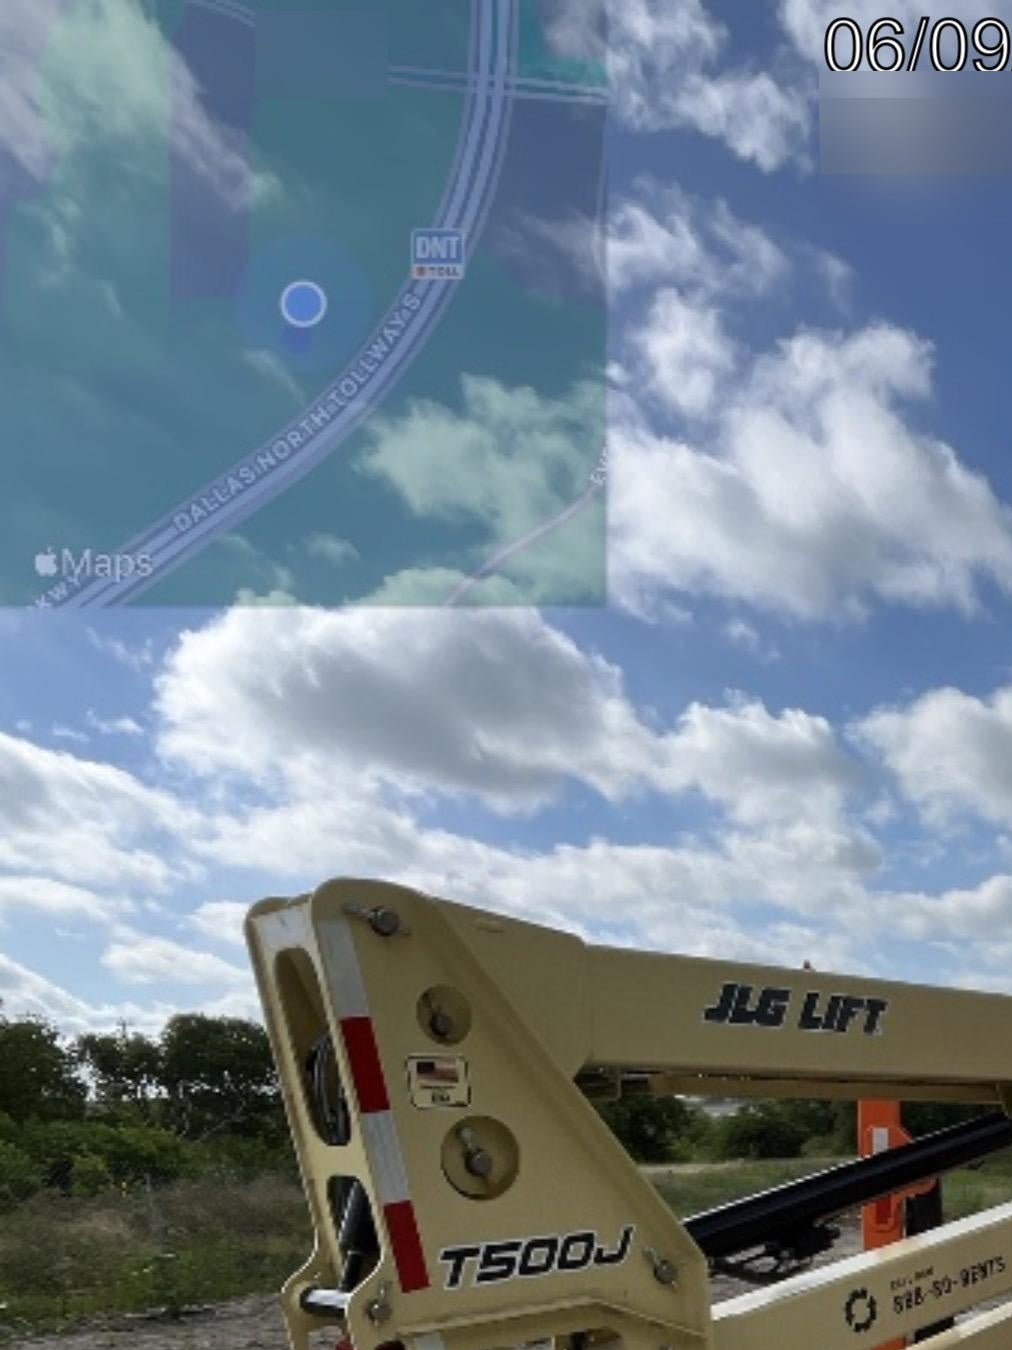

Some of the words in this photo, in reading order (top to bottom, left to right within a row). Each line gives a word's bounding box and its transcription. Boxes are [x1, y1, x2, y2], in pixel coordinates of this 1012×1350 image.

[703, 982, 792, 1029] JLG
[798, 991, 890, 1037] LIFT
[440, 1224, 636, 1290] T500J
